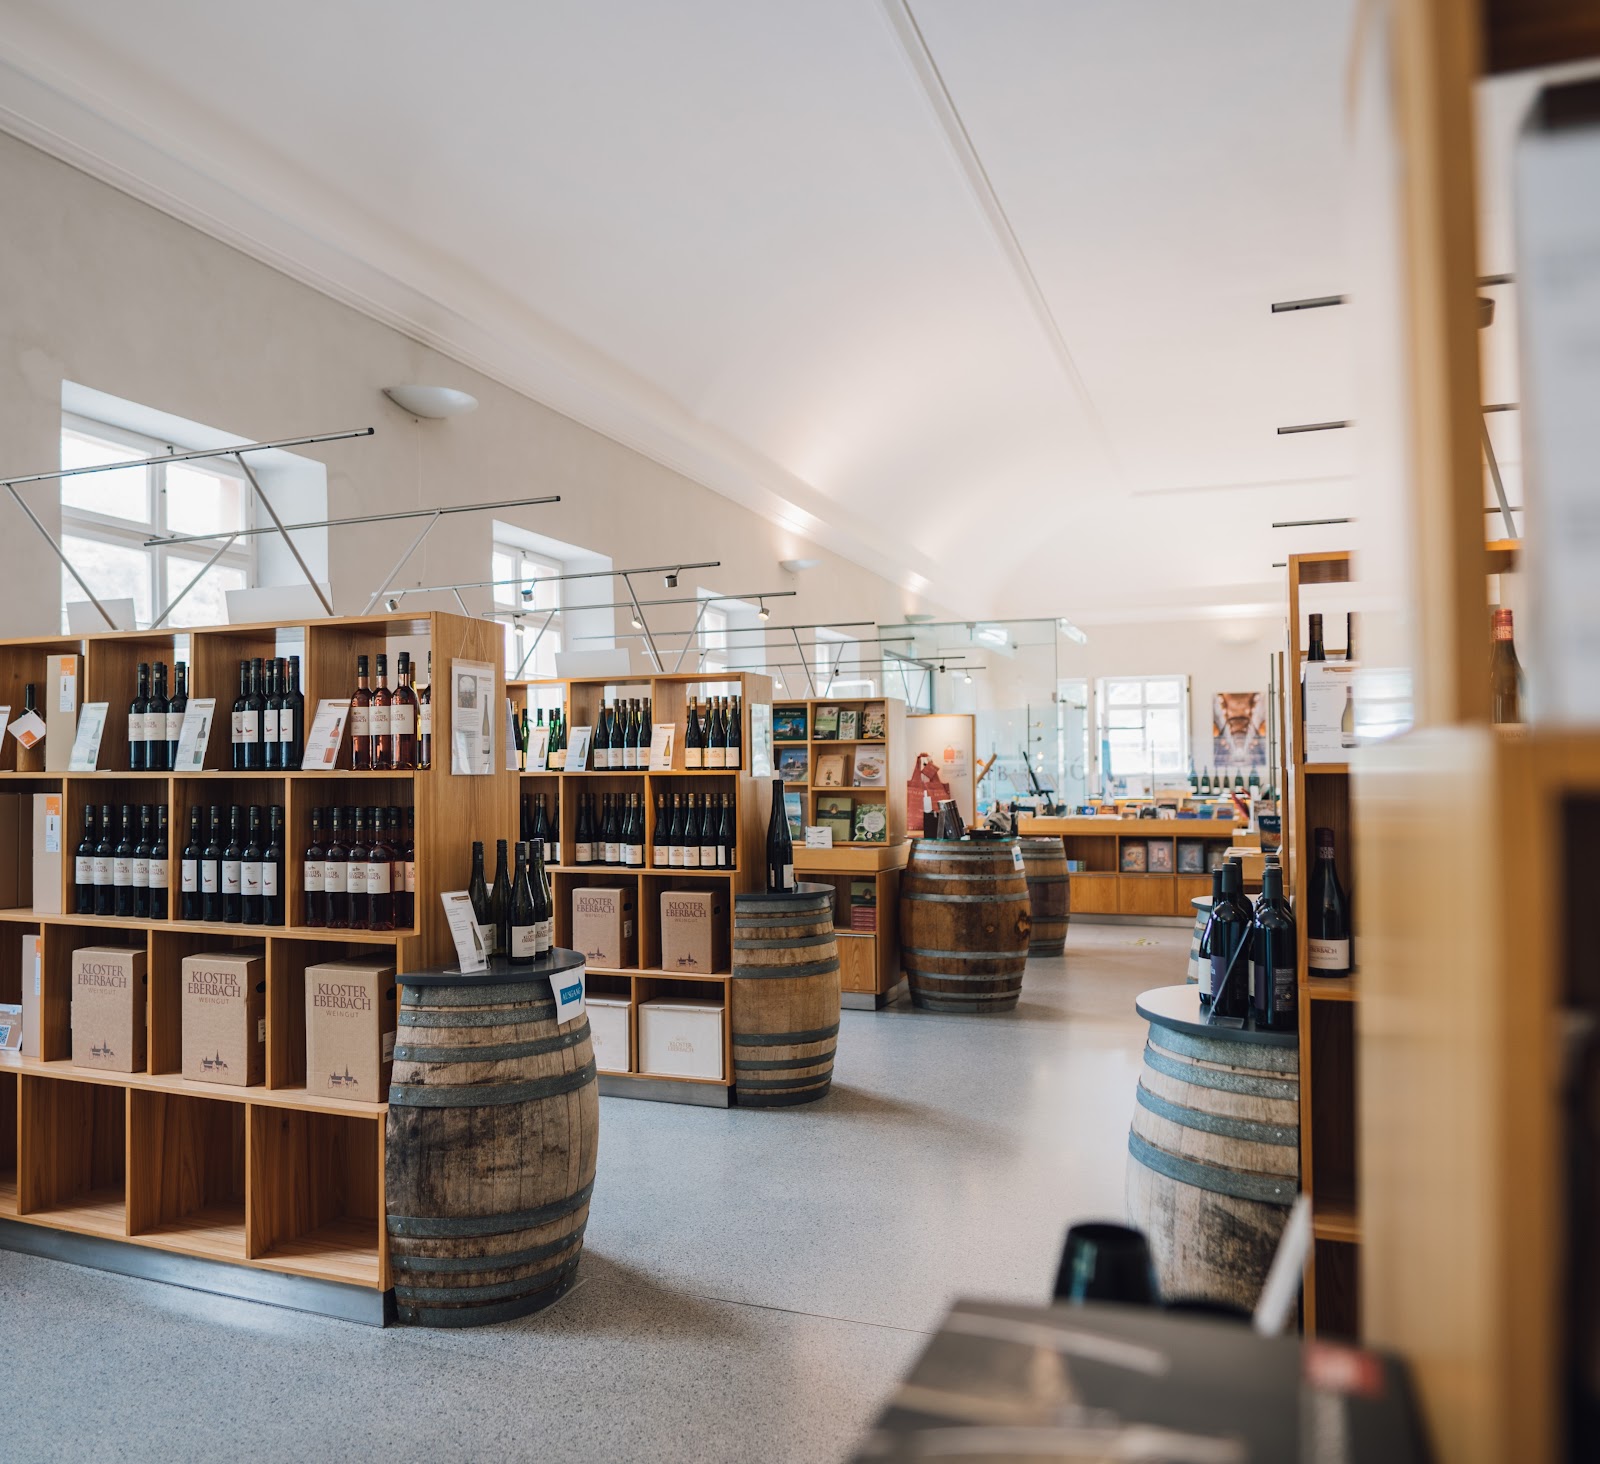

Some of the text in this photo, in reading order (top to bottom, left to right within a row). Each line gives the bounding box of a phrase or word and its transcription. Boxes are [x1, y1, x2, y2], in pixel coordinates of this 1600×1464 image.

[579, 896, 613, 906] KLOSTER
[668, 901, 703, 910] KLOSTER
[576, 903, 615, 914] EBERBACH
[665, 909, 707, 918] EBERBACH
[82, 962, 125, 977] KLOSTER
[77, 973, 127, 989] EBERBACH
[191, 970, 239, 986] KLOSTER
[187, 982, 241, 998] EBERBACH
[317, 982, 369, 998] KLOSTER
[198, 996, 230, 1004] WEINGUT
[313, 994, 371, 1011] EBERBACH
[325, 1010, 359, 1018] WEINGUT
